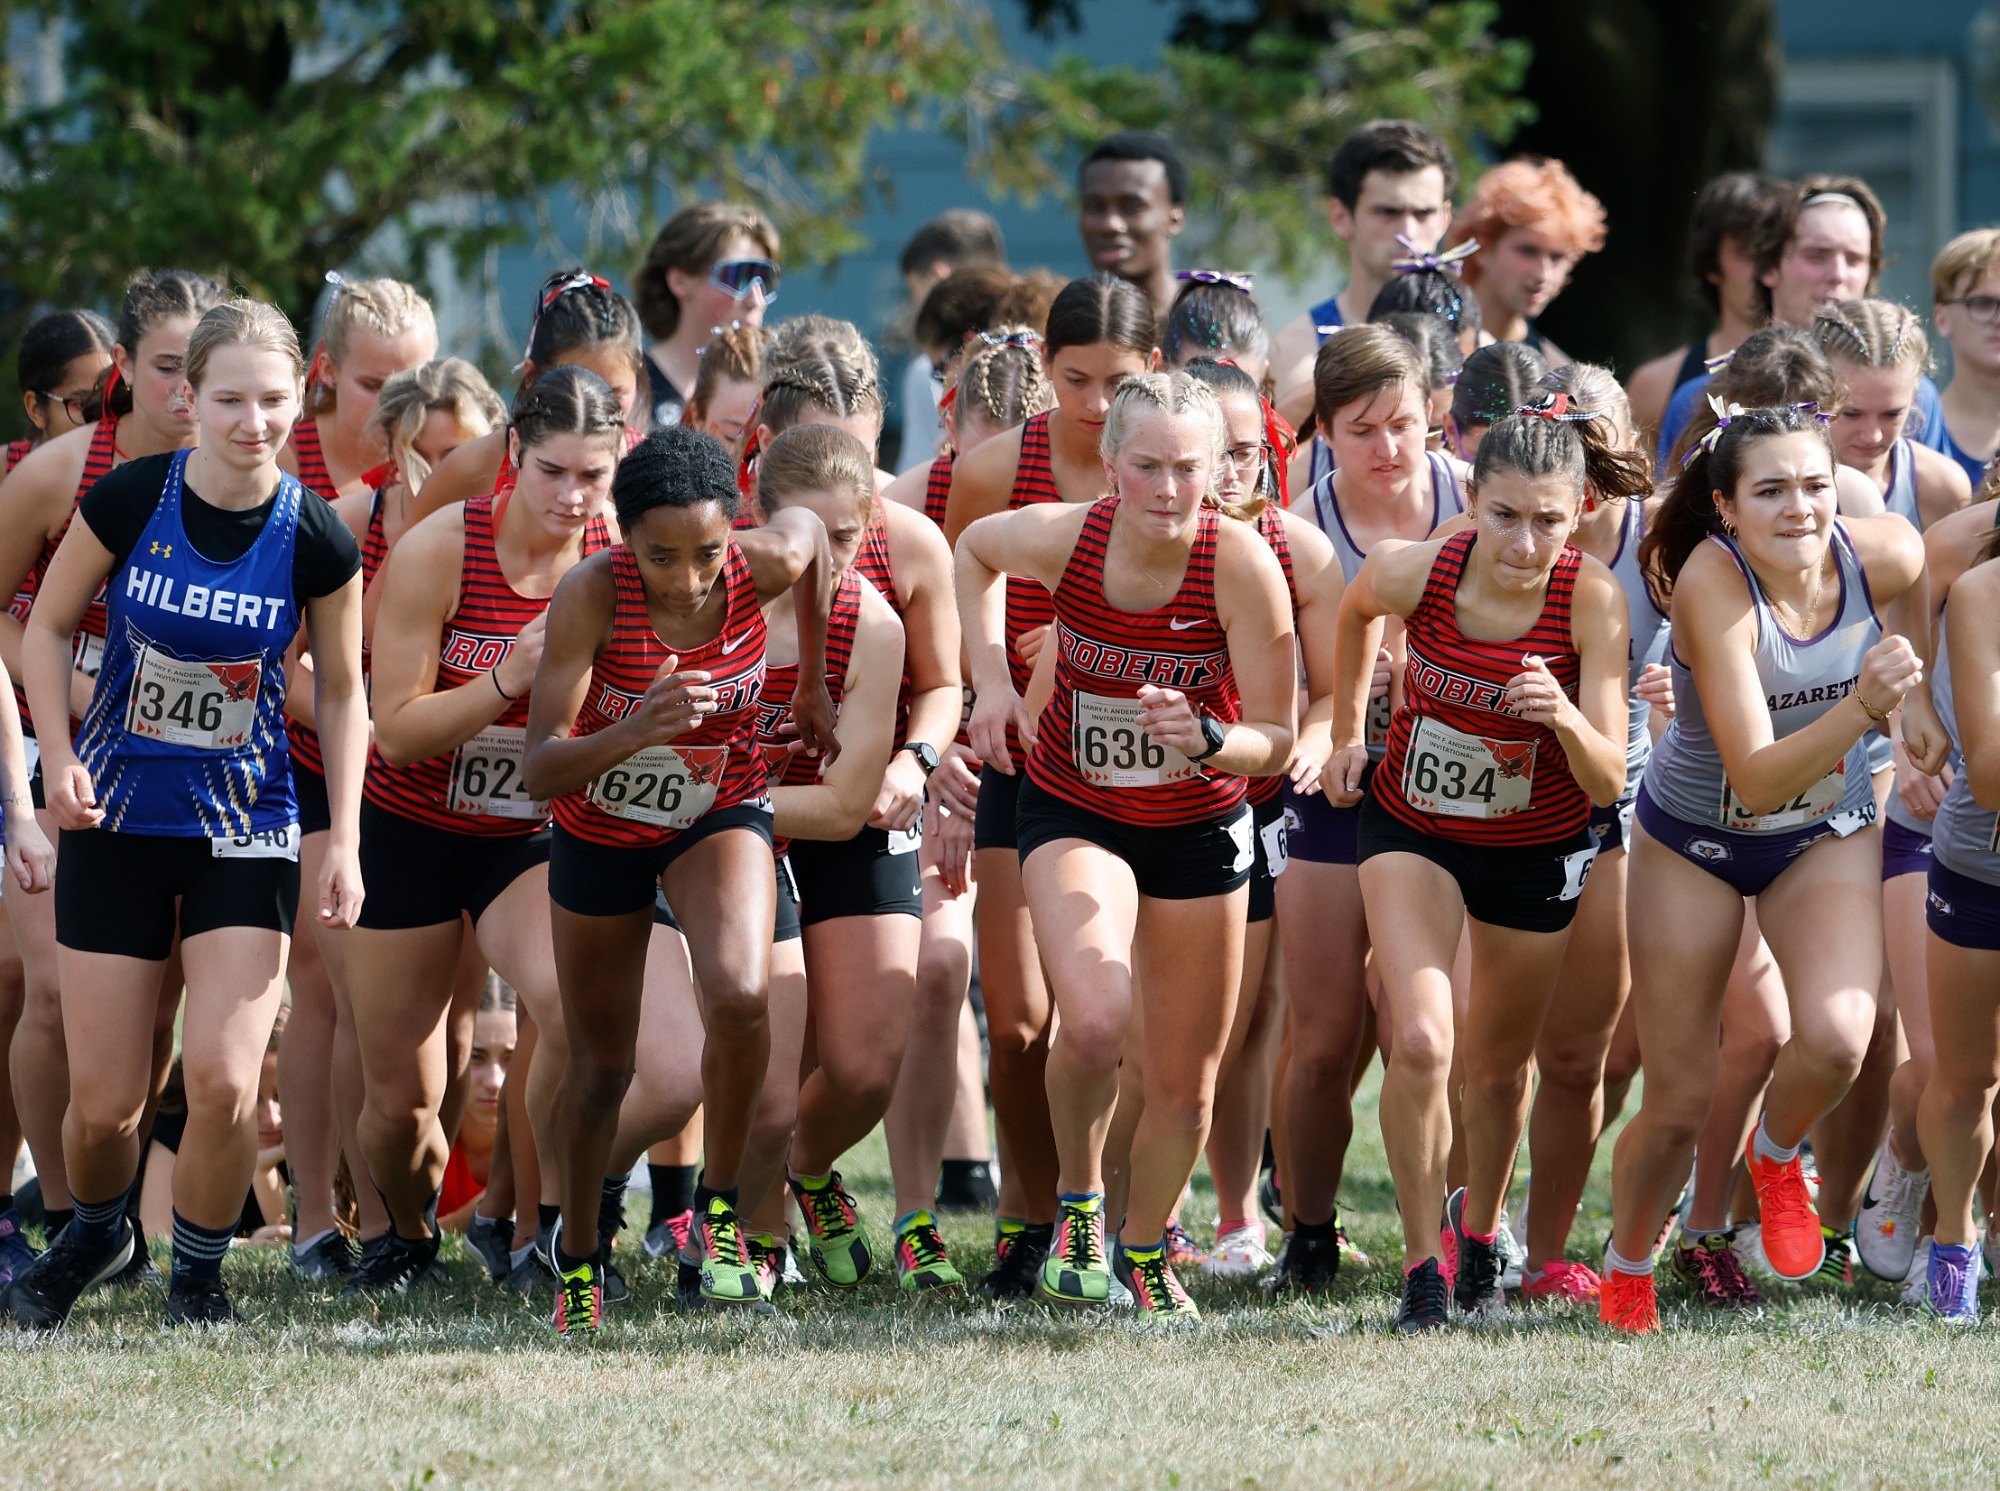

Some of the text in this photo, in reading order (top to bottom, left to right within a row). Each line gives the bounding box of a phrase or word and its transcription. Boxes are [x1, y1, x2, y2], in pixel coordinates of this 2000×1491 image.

[126, 566, 285, 630] HILBERT
[145, 659, 167, 671] HARRY
[174, 670, 213, 679] ANDERSON
[1059, 629, 1225, 687] ROBERTS
[154, 671, 201, 686] INVITATIONAL
[140, 681, 224, 731] 346
[1081, 703, 1102, 713] HARRY
[1110, 708, 1146, 716] ANDERSO
[1091, 714, 1135, 723] INVITATIONA
[1085, 726, 1165, 769] 636
[1420, 728, 1441, 741] HARRY
[1447, 740, 1486, 752] ANDERSON
[1429, 741, 1474, 760] INVITATIONAL
[601, 770, 685, 812] 626
[1414, 752, 1496, 803] 634
